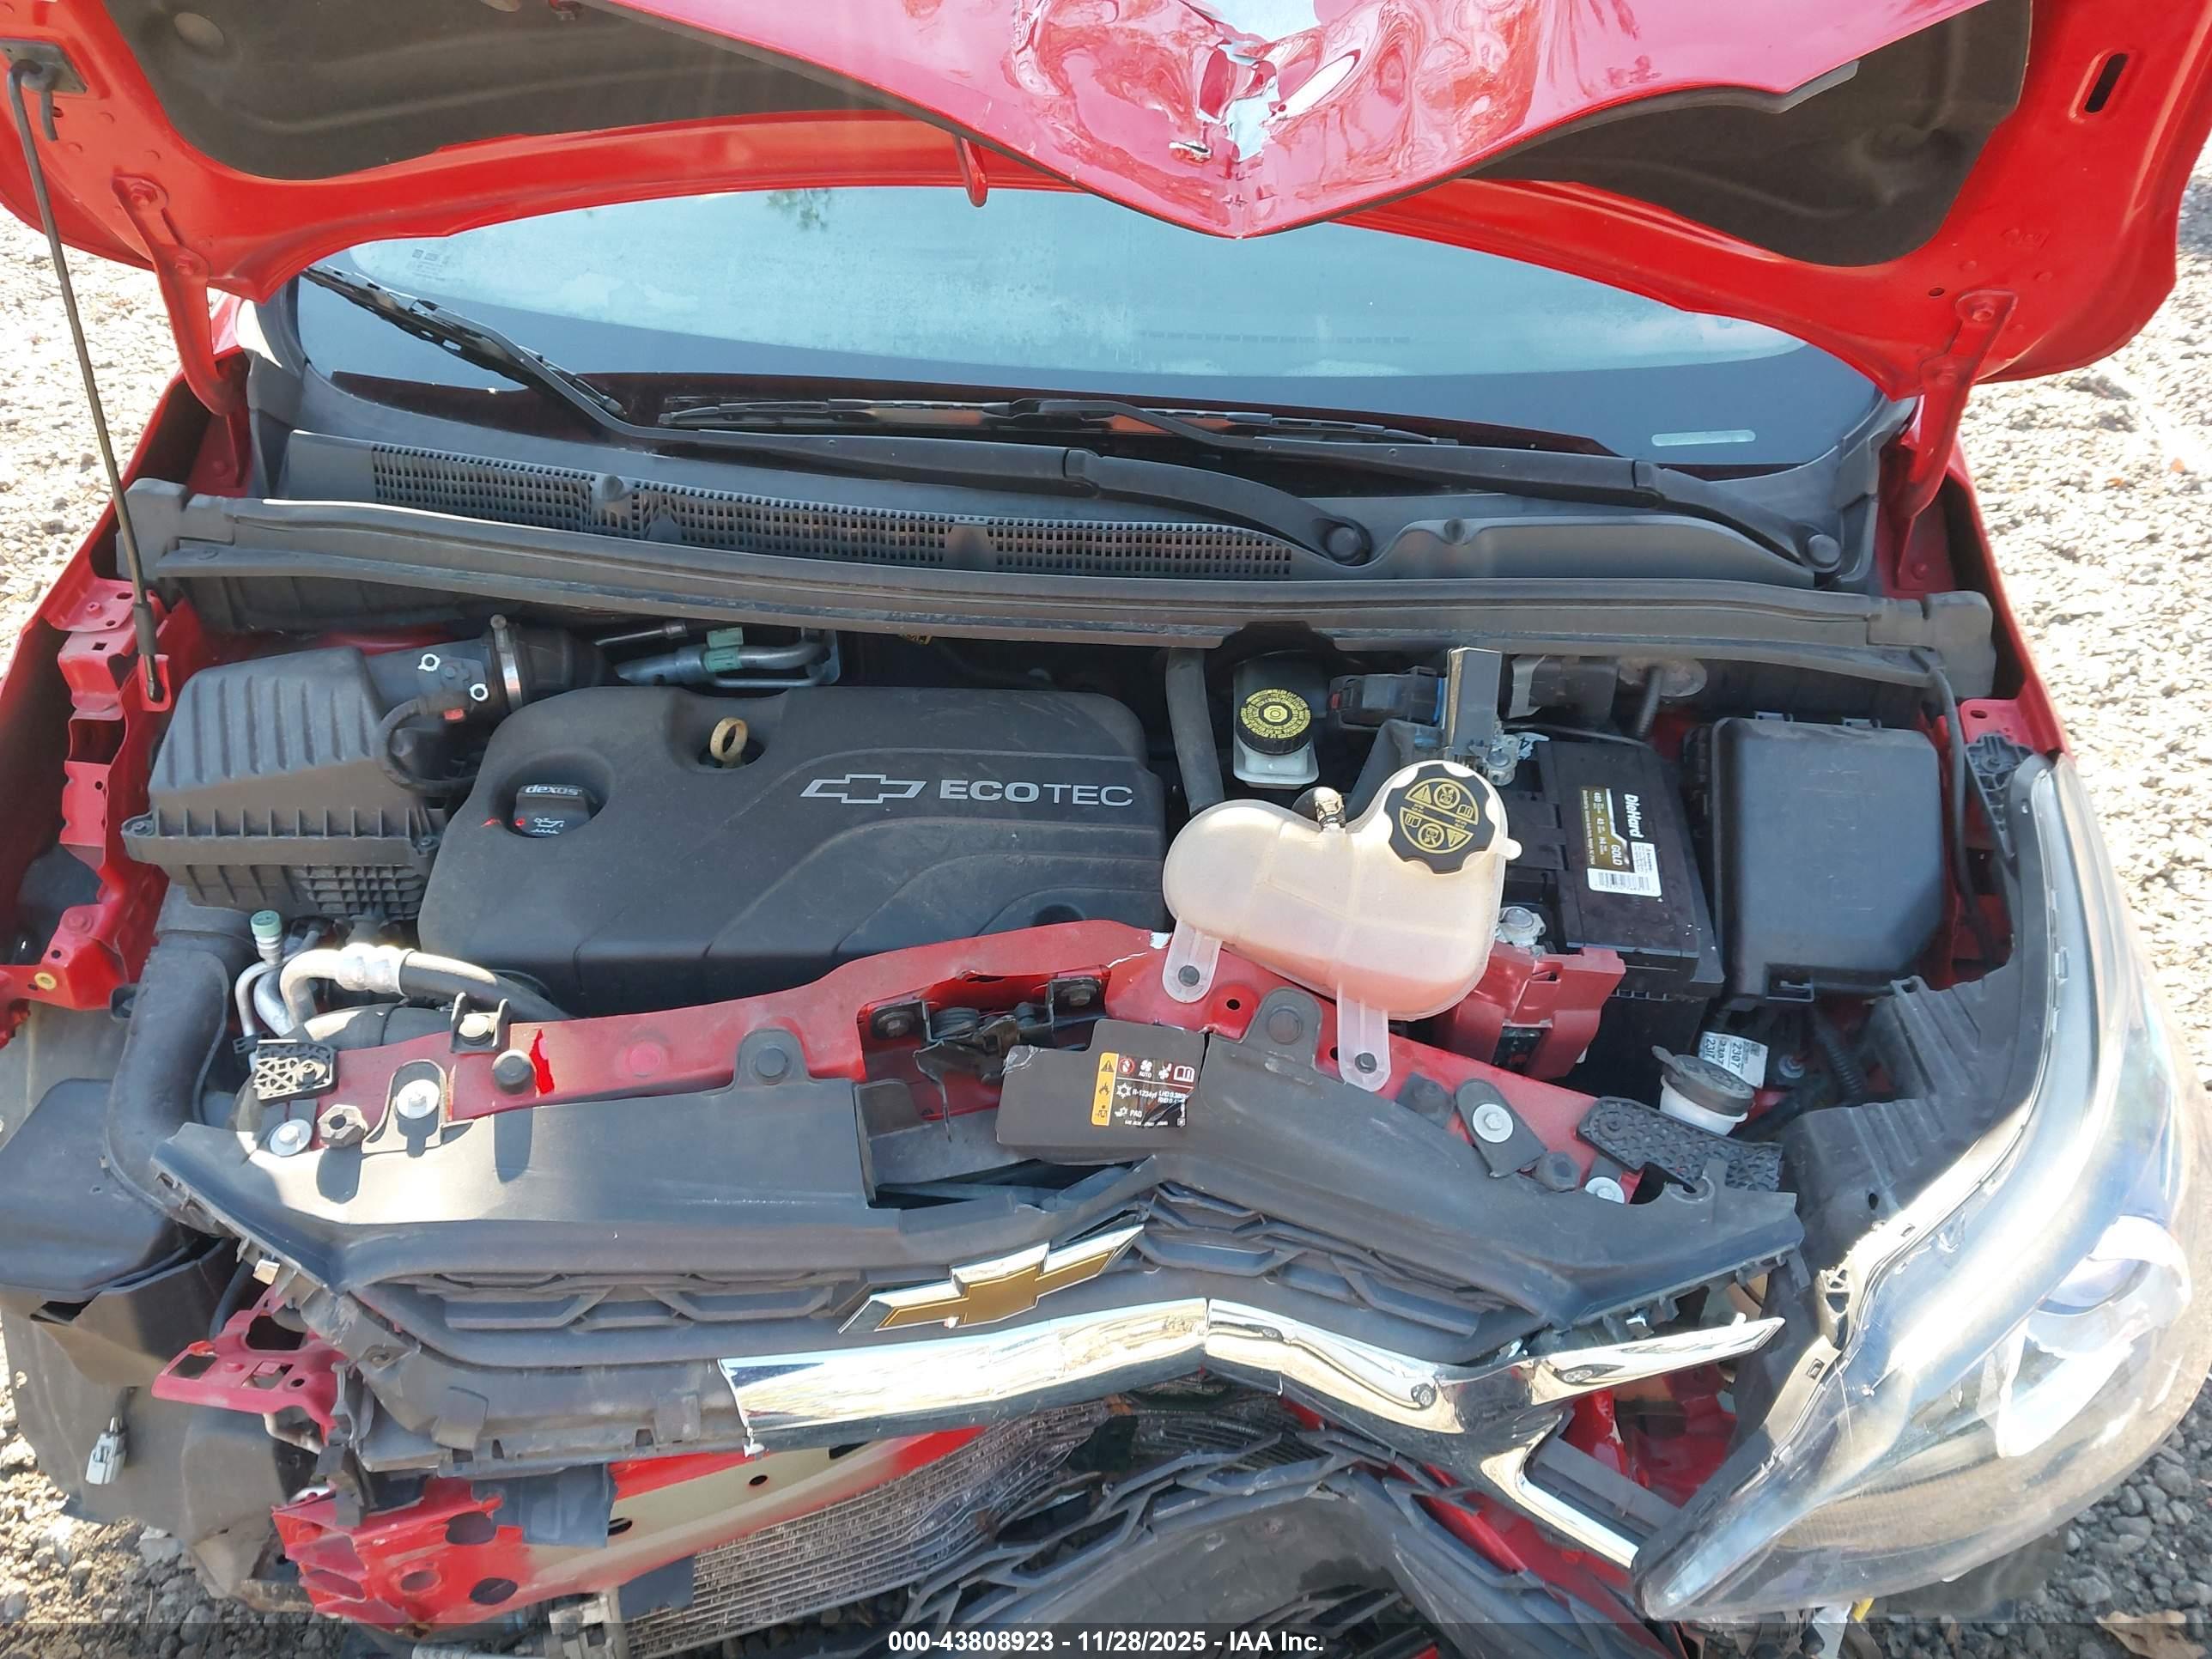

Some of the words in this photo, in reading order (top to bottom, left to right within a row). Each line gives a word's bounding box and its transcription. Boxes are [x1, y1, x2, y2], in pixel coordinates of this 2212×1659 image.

[525, 784, 579, 796] dexos
[939, 780, 1133, 806] ECOTEC
[1624, 793, 1644, 839] DieHard
[1611, 844, 1623, 866] GOLD
[1731, 1042, 1741, 1068] 2307
[1132, 1088, 1158, 1100] R-1234yf
